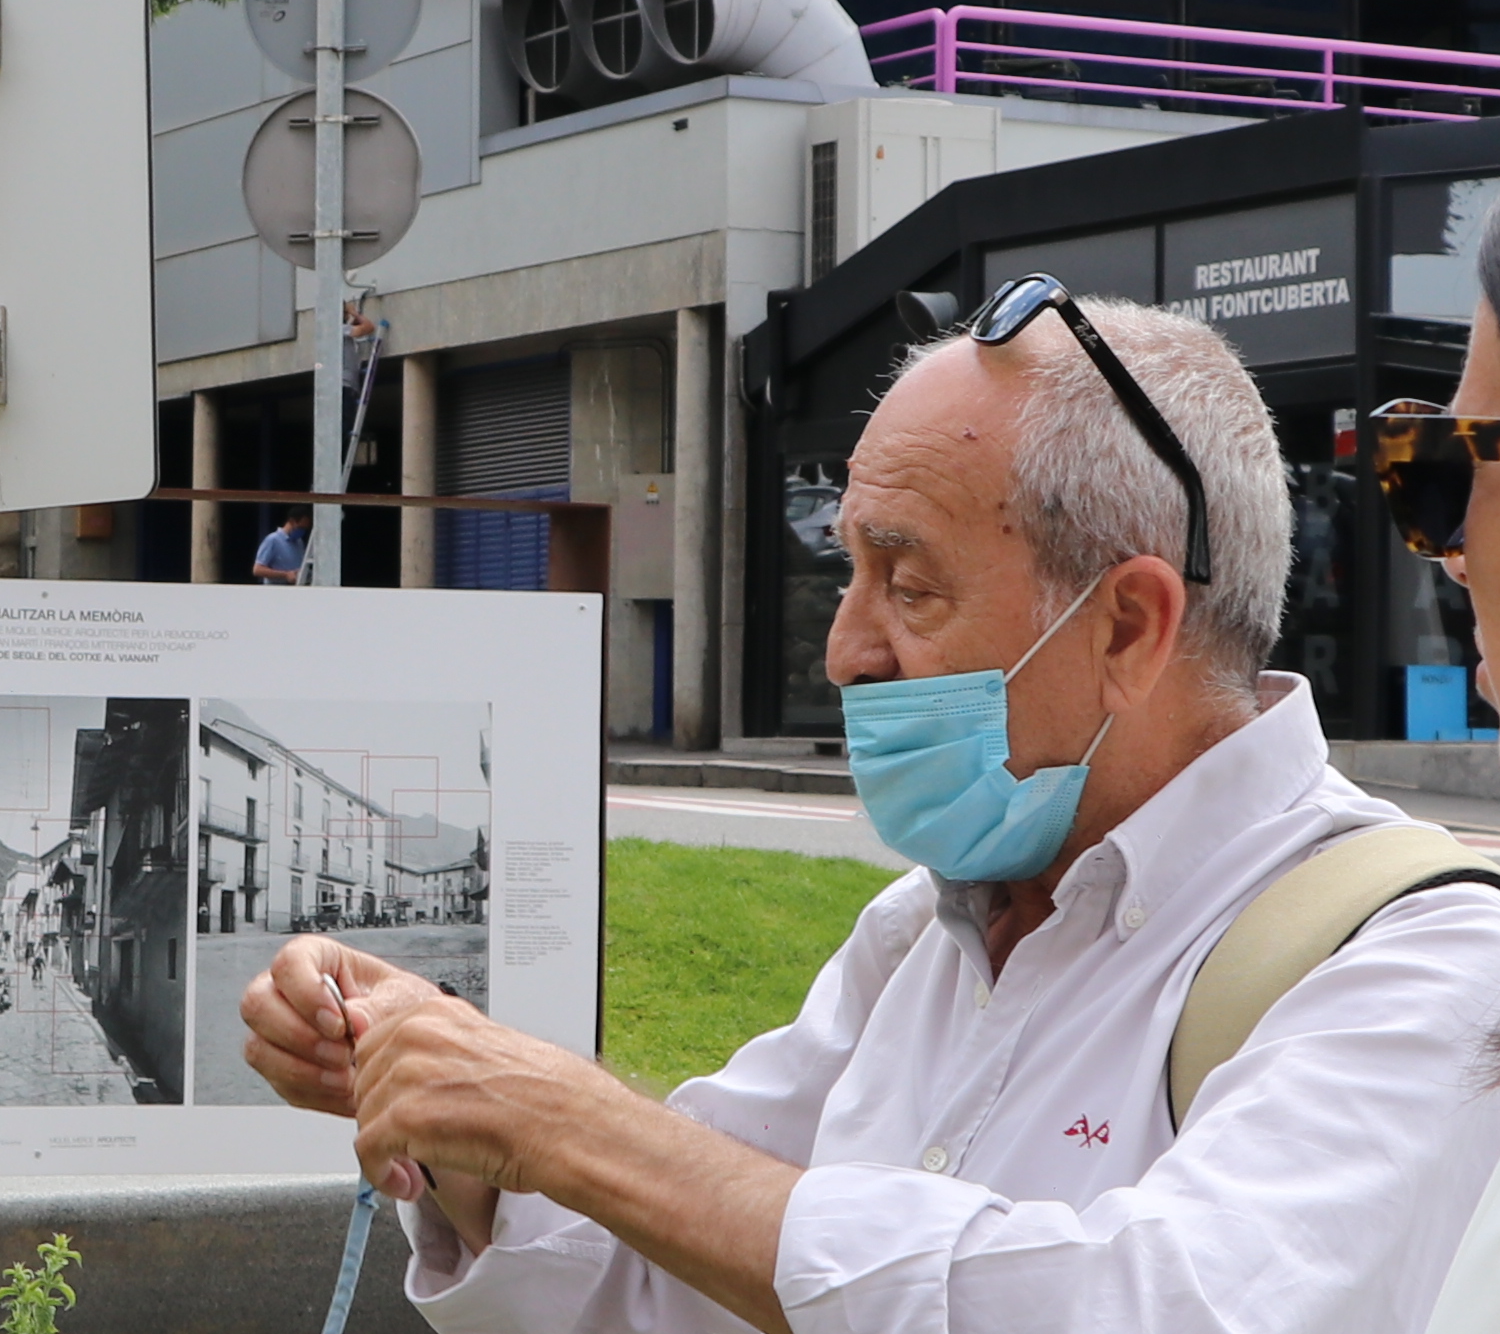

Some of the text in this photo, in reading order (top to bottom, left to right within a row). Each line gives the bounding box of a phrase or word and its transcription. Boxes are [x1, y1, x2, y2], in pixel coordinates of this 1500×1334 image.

[1196, 247, 1321, 290] RESTAURANT
[1169, 277, 1350, 320] CAN FONTCUBERTA
[59, 610, 76, 622] LA
[79, 609, 145, 623] MEMÒRIA
[131, 629, 150, 639] PER
[151, 629, 164, 639] LA
[48, 651, 67, 661] DEL
[69, 652, 102, 662] COTXE
[104, 653, 117, 663] AL
[118, 653, 160, 663] VIANANT
